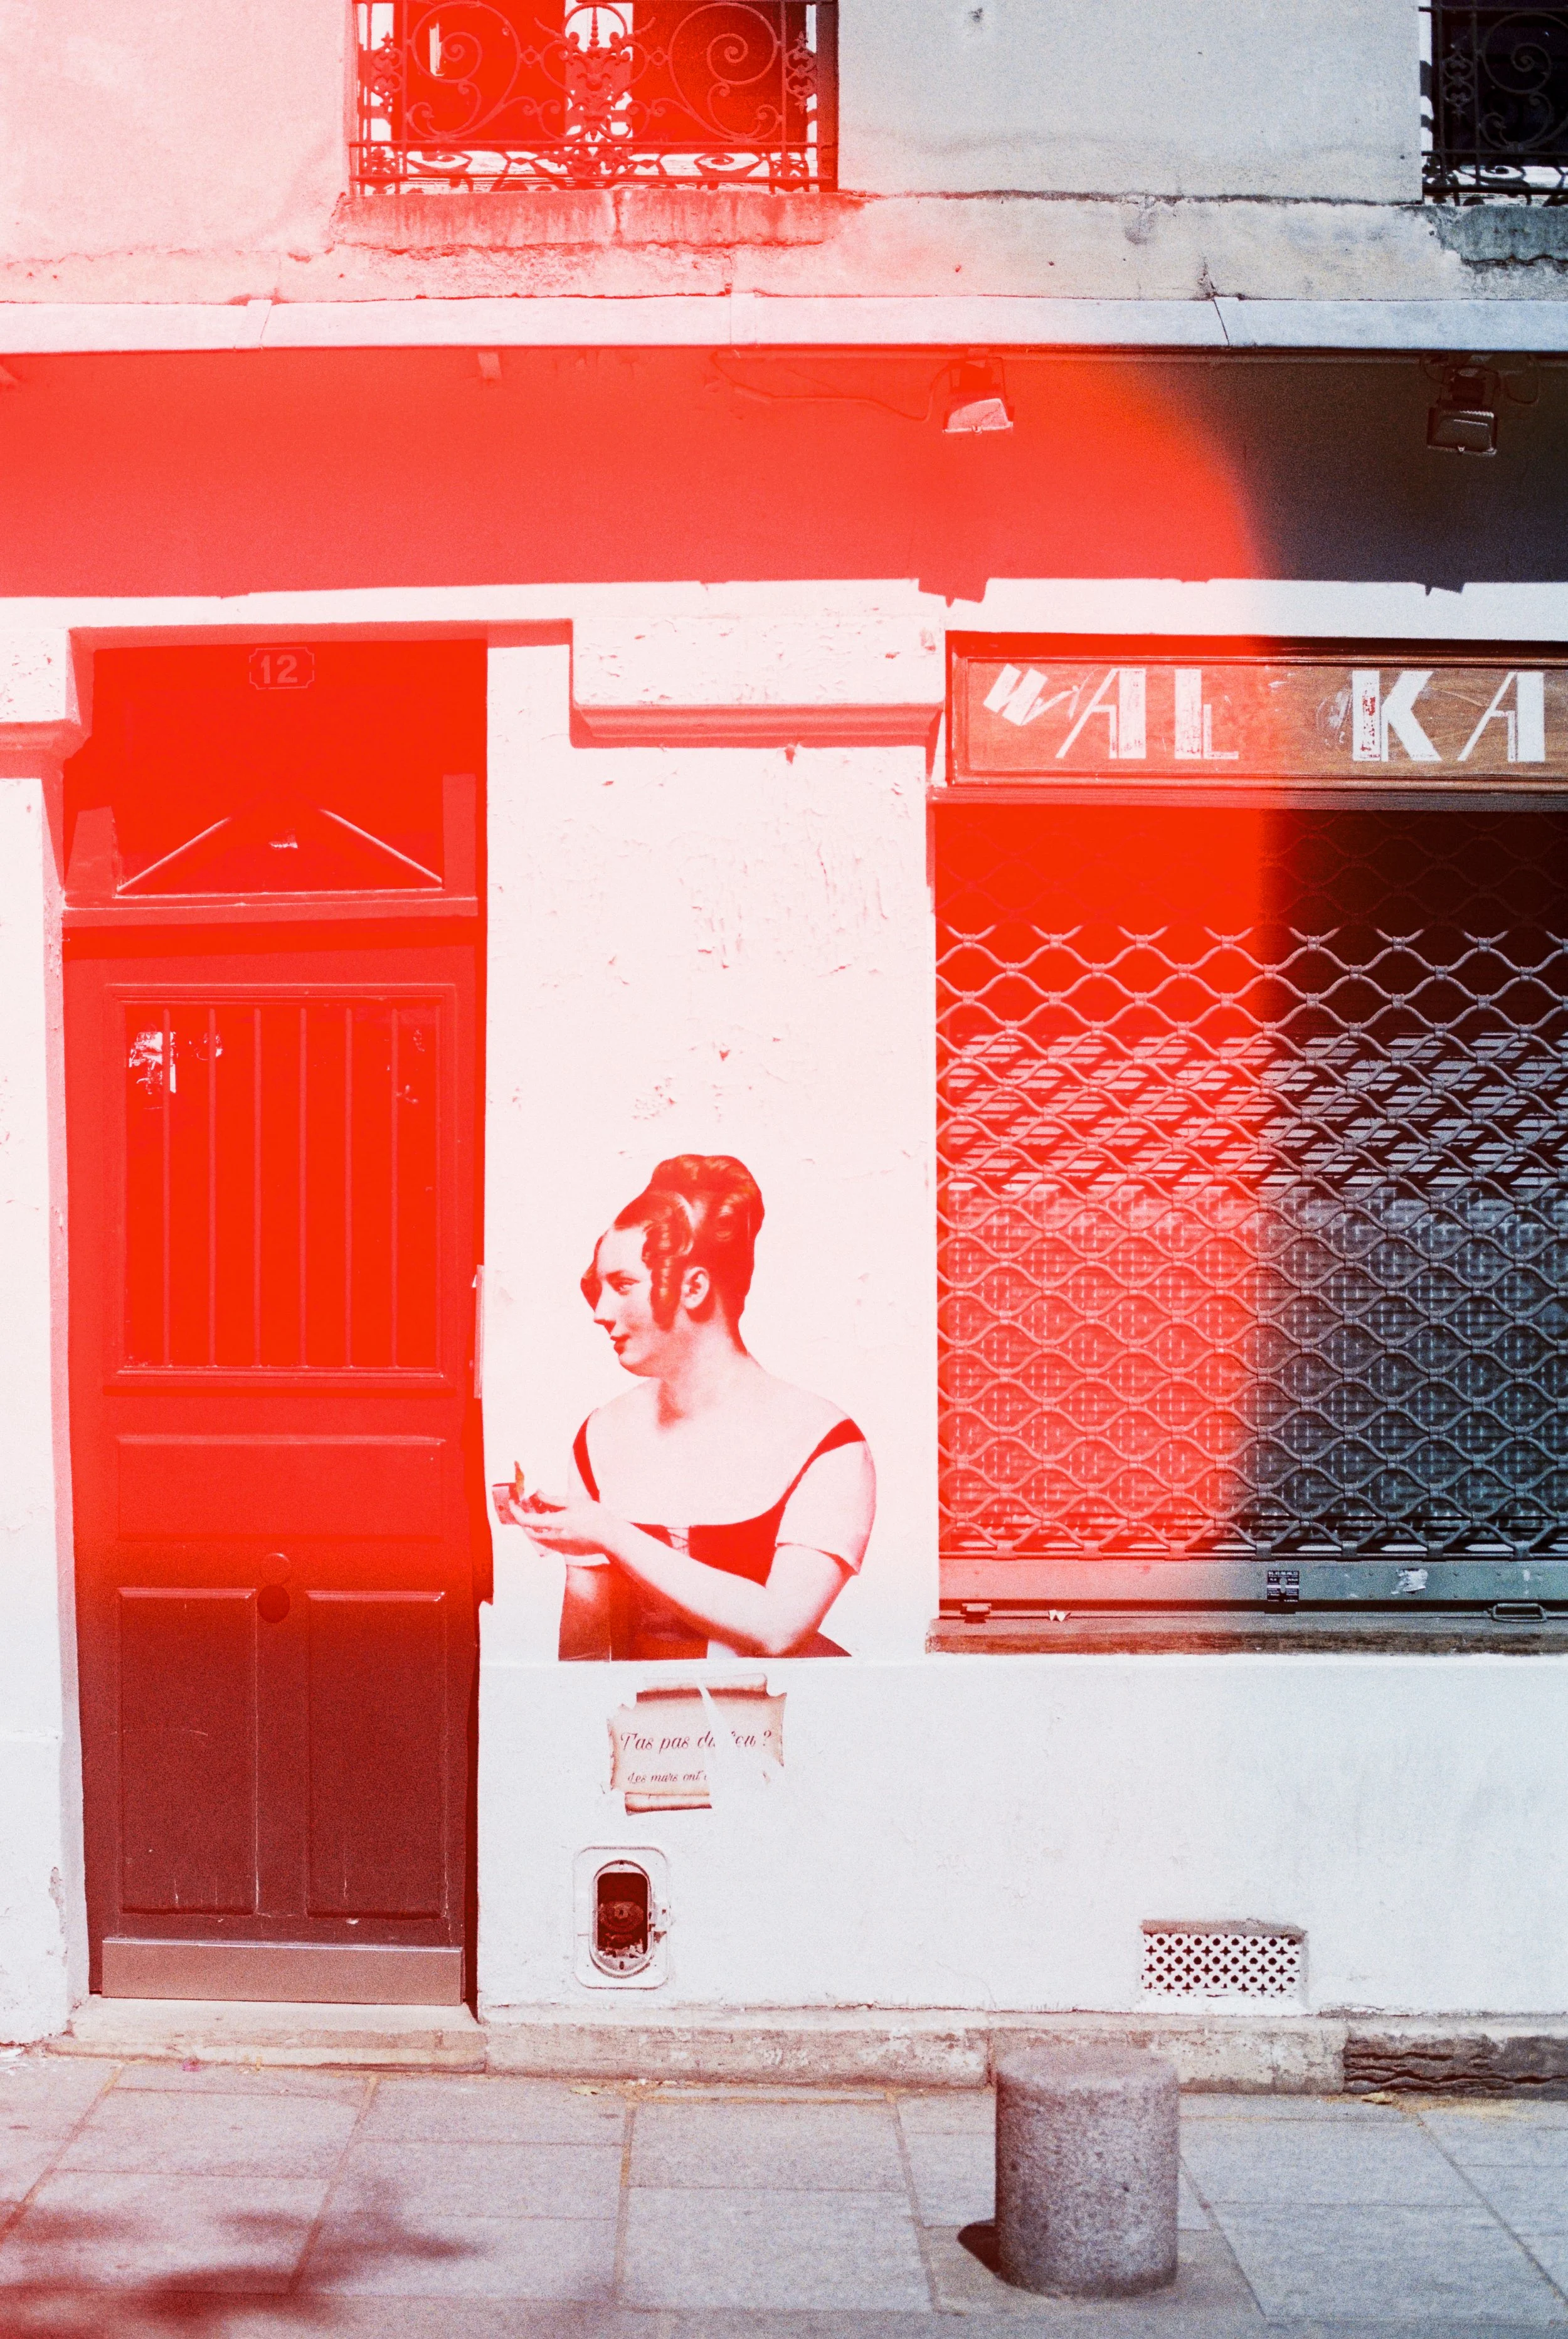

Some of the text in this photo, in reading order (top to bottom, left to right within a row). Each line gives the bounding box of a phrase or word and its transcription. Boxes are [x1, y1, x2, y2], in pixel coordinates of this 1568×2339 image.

[260, 654, 298, 684] 12
[659, 1736, 690, 1754] pas
[731, 1731, 756, 1748] eu
